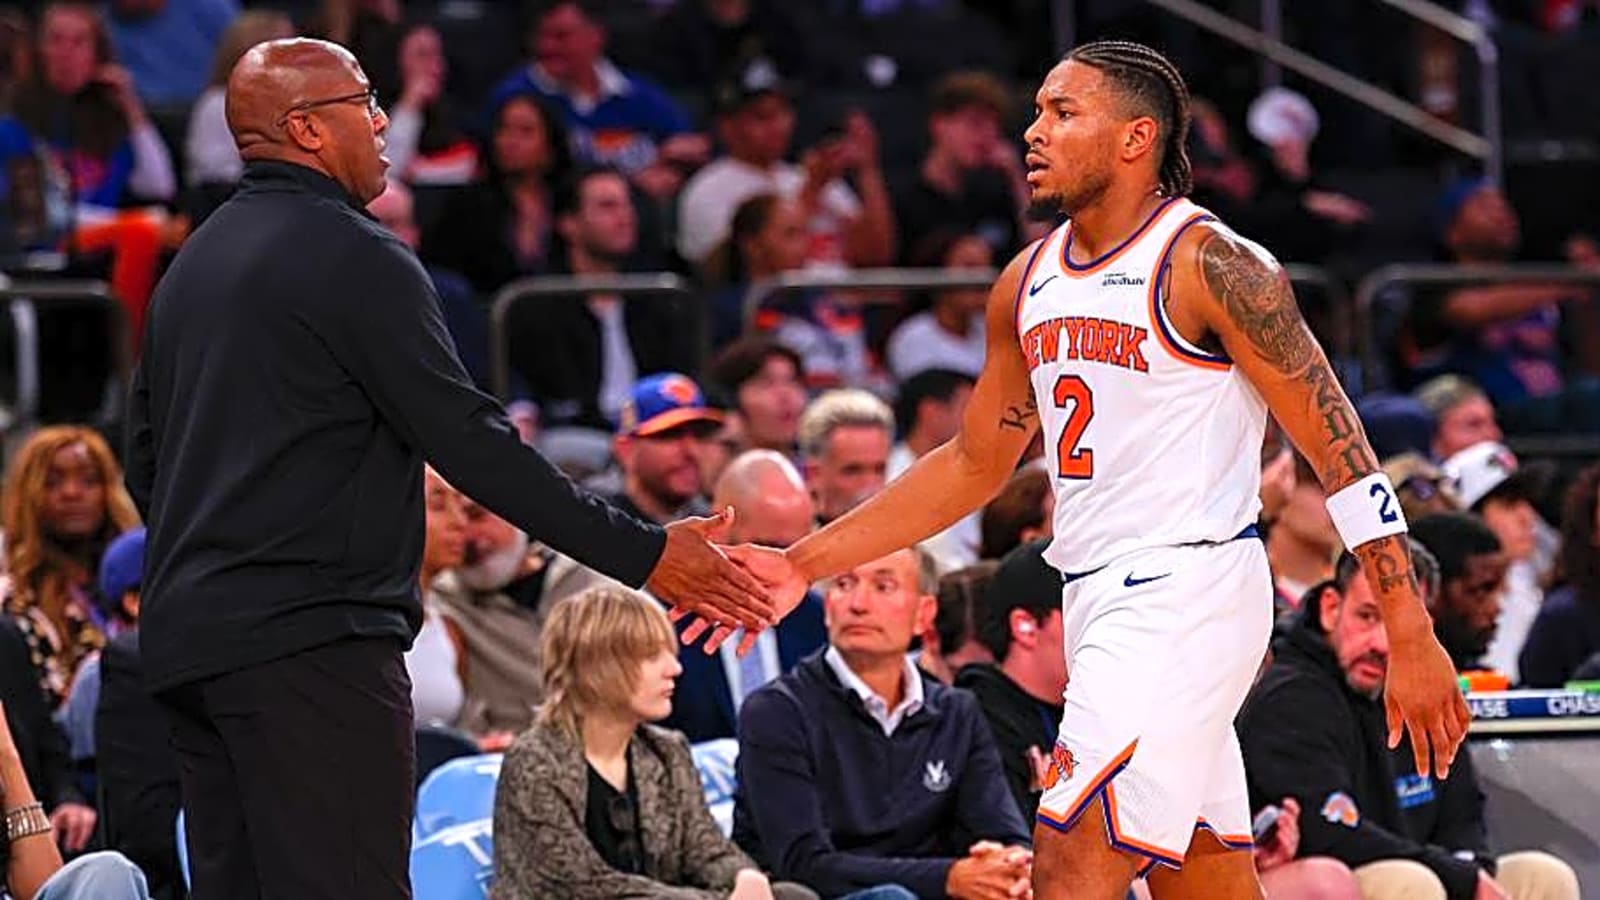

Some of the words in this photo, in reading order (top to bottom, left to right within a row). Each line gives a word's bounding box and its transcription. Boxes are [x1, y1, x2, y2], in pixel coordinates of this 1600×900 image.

[1065, 316, 1149, 373] YORK
[1053, 374, 1094, 480] 2
[1369, 483, 1398, 524] 2
